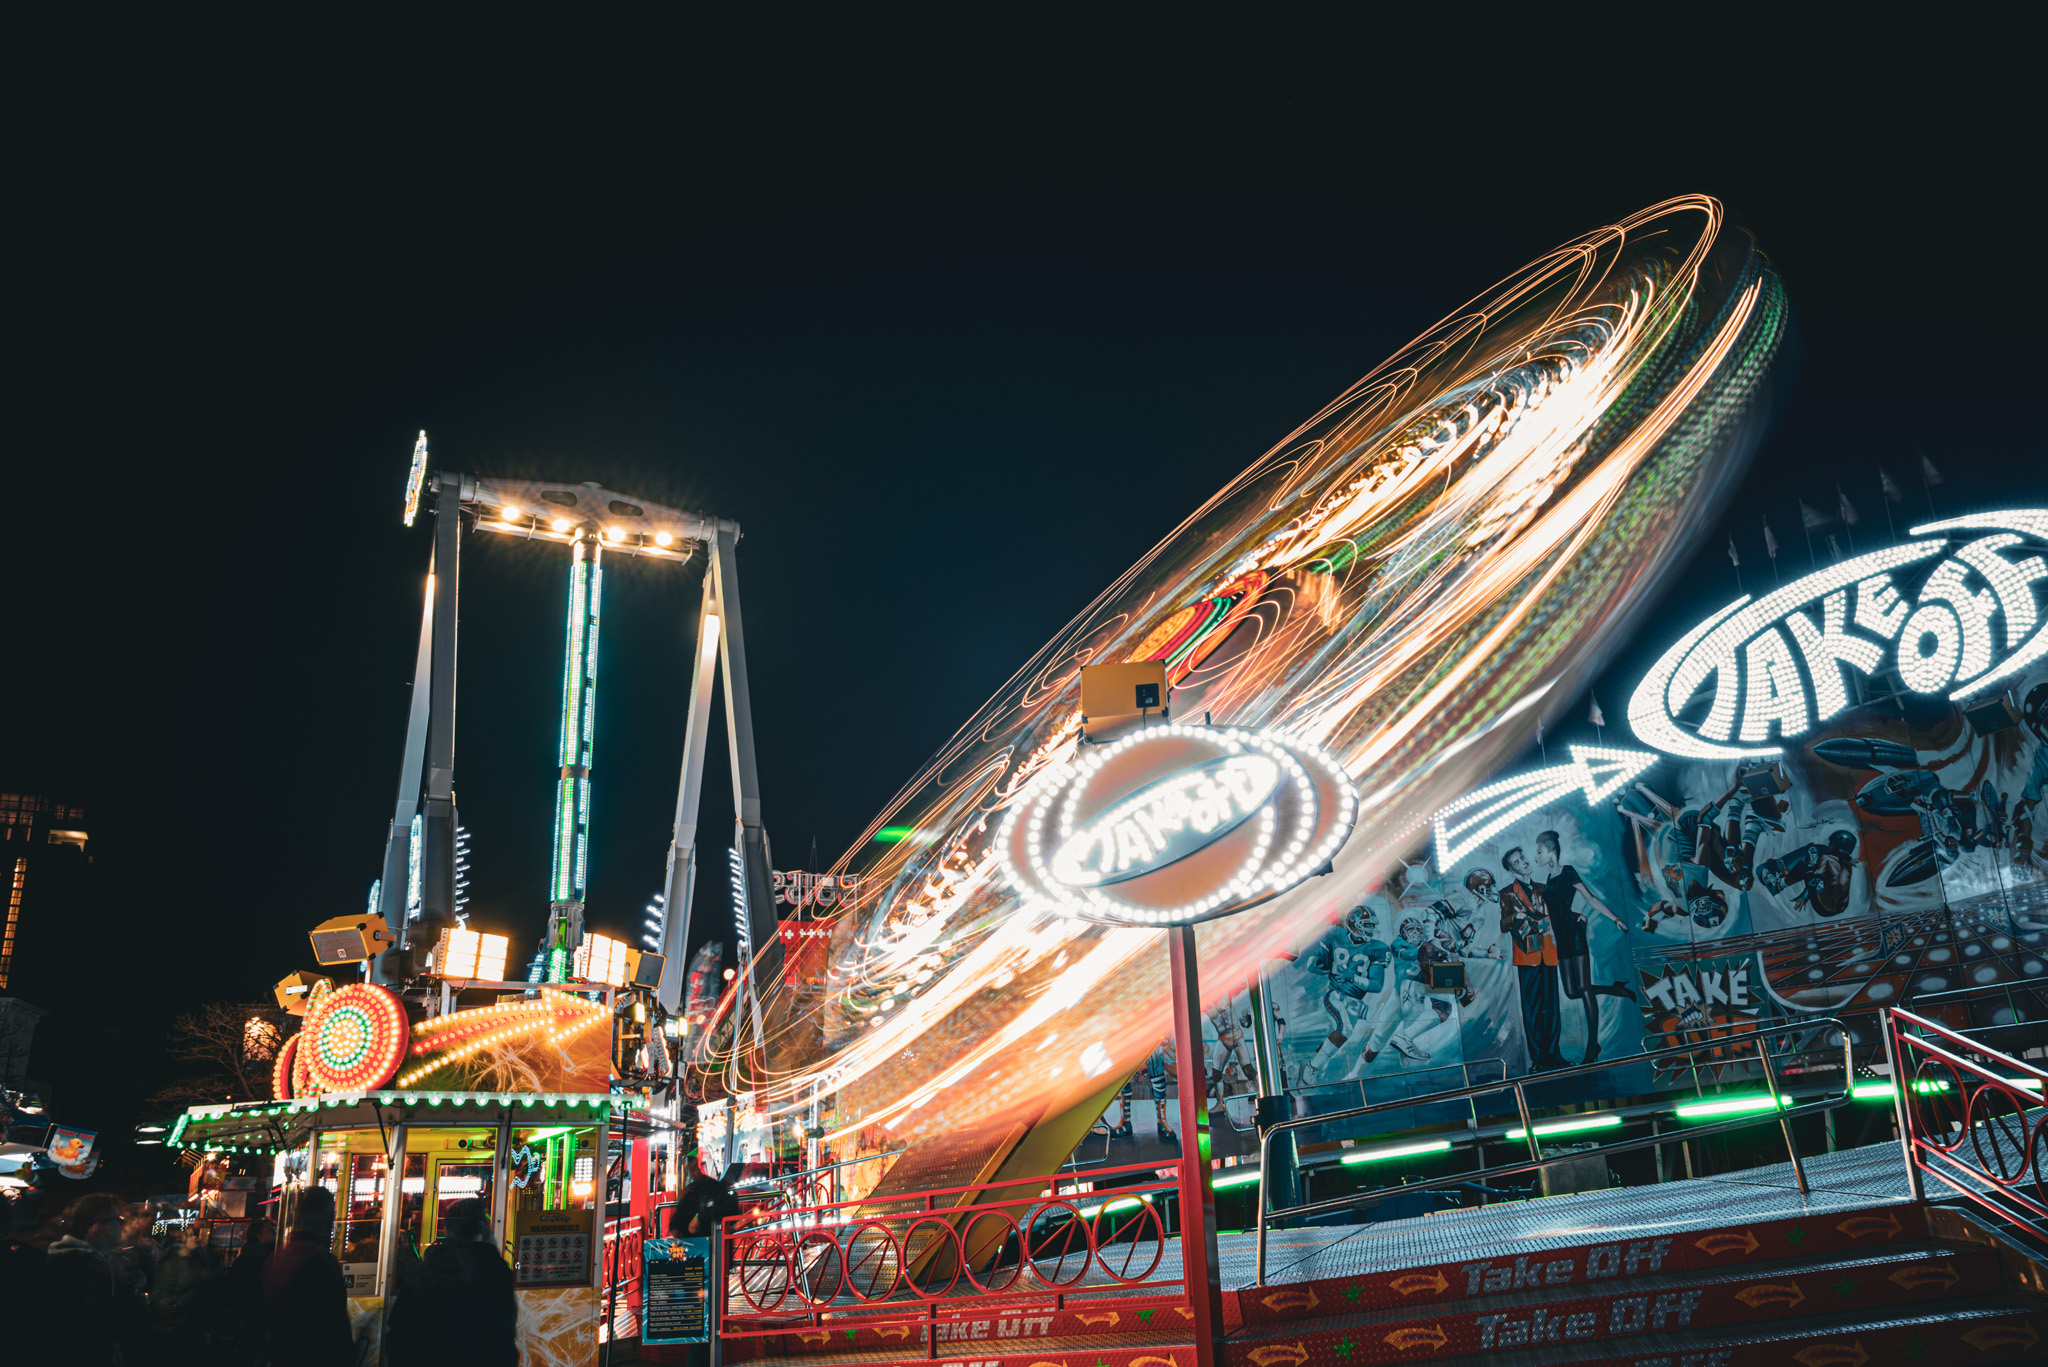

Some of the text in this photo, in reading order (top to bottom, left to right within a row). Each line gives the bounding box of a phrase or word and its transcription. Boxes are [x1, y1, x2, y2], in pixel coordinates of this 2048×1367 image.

[1667, 532, 2048, 742] TAKE OFF
[1331, 948, 1370, 979] 83
[1645, 969, 1750, 1012] TAKE
[1460, 1256, 1575, 1296] Take
[1474, 1308, 1597, 1350] Take
